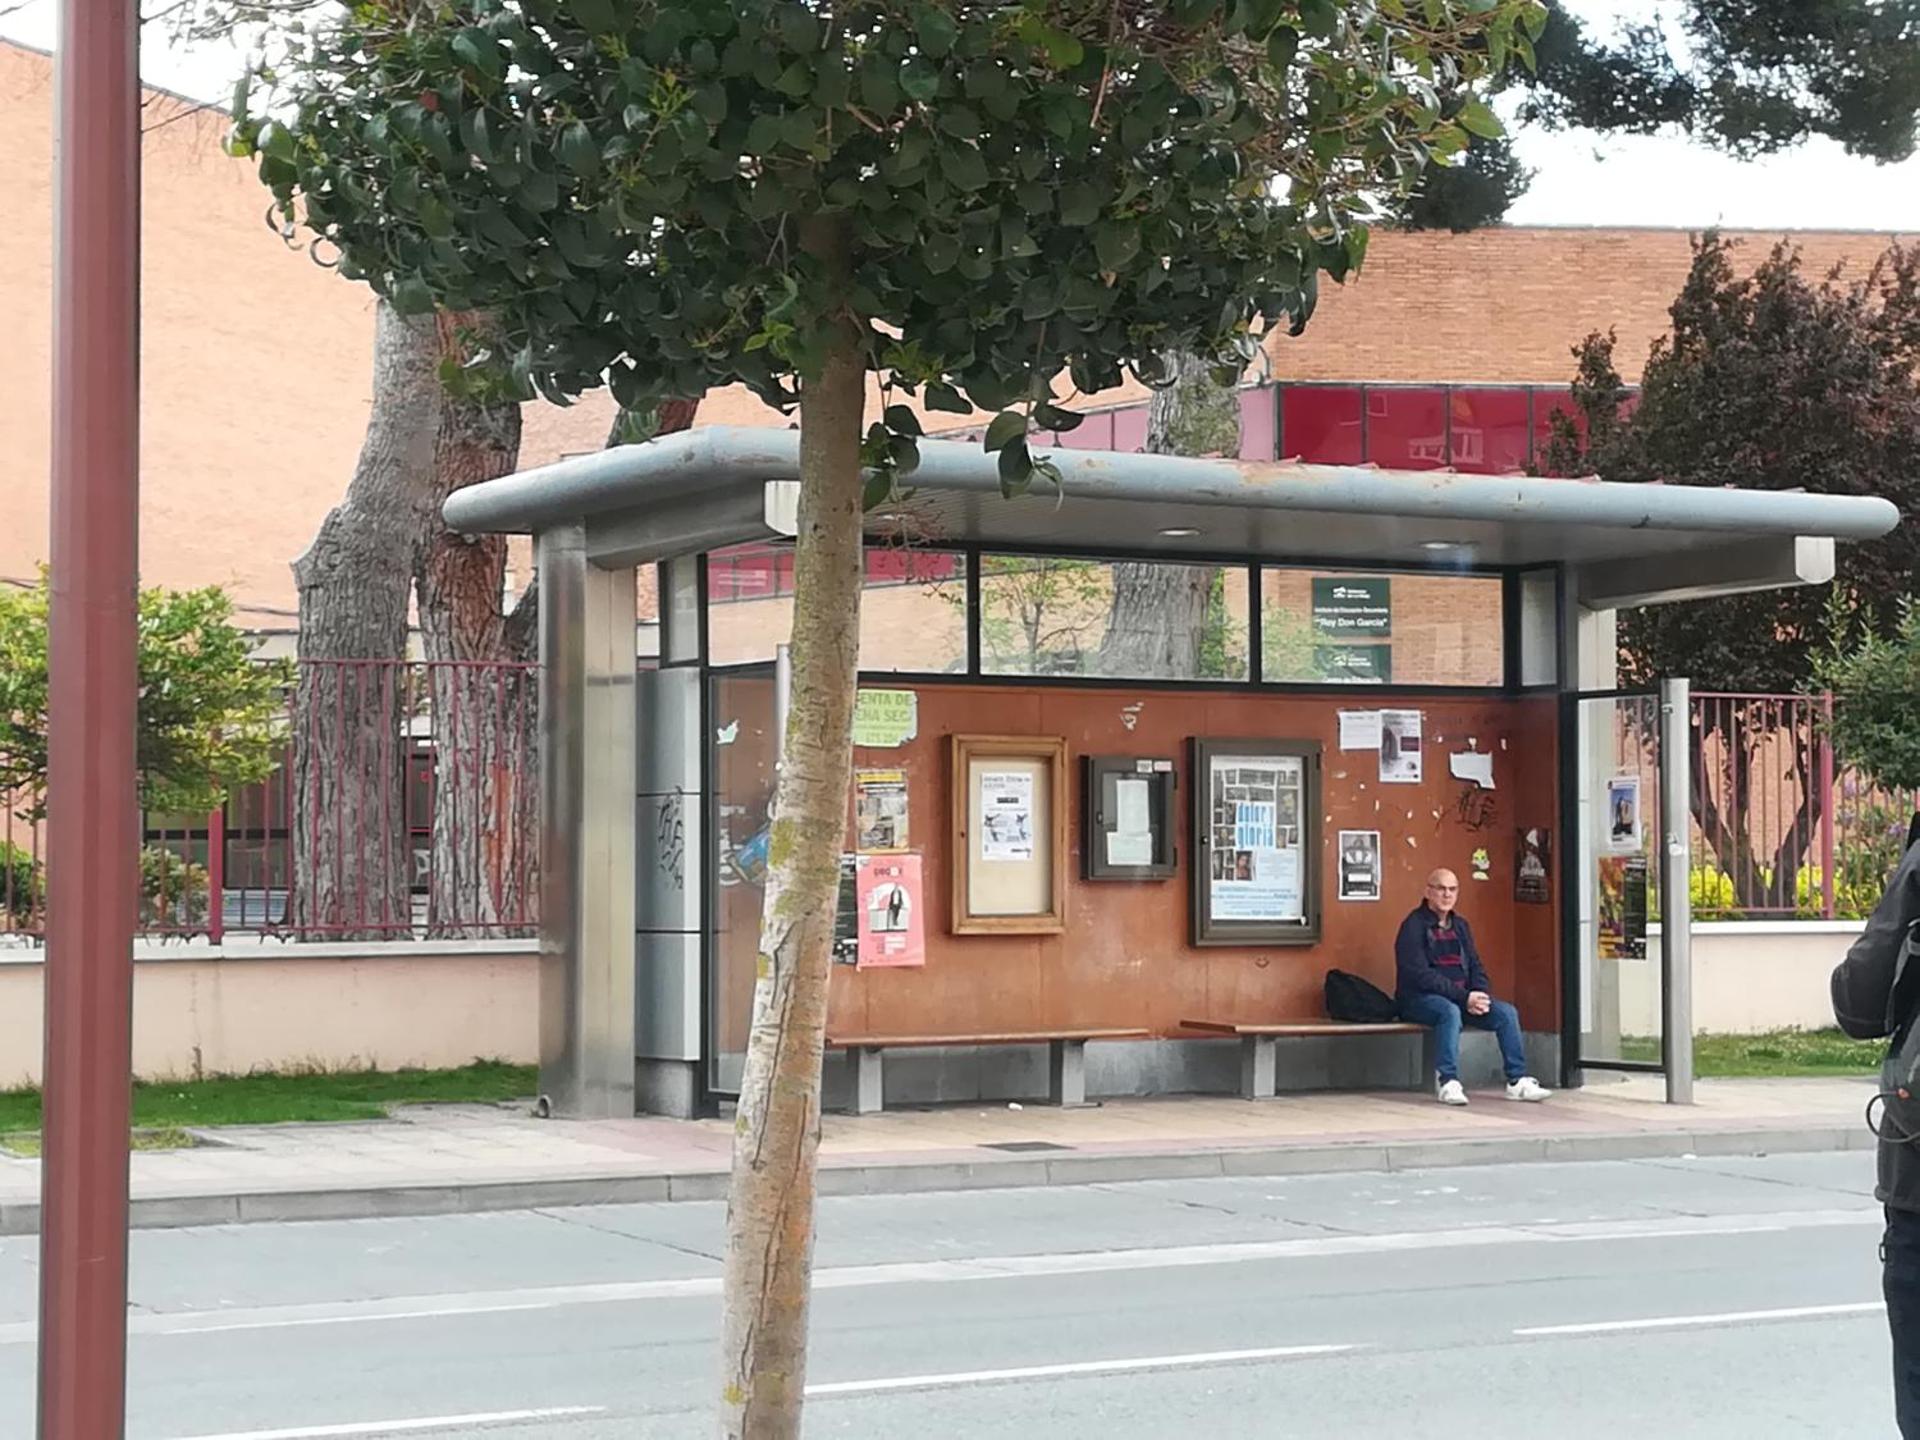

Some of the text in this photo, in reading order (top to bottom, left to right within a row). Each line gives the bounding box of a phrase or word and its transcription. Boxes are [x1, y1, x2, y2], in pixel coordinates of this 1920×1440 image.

[1337, 618, 1355, 627] Don
[858, 692, 913, 706] ENTA DE
[1237, 825, 1274, 848] gloria
